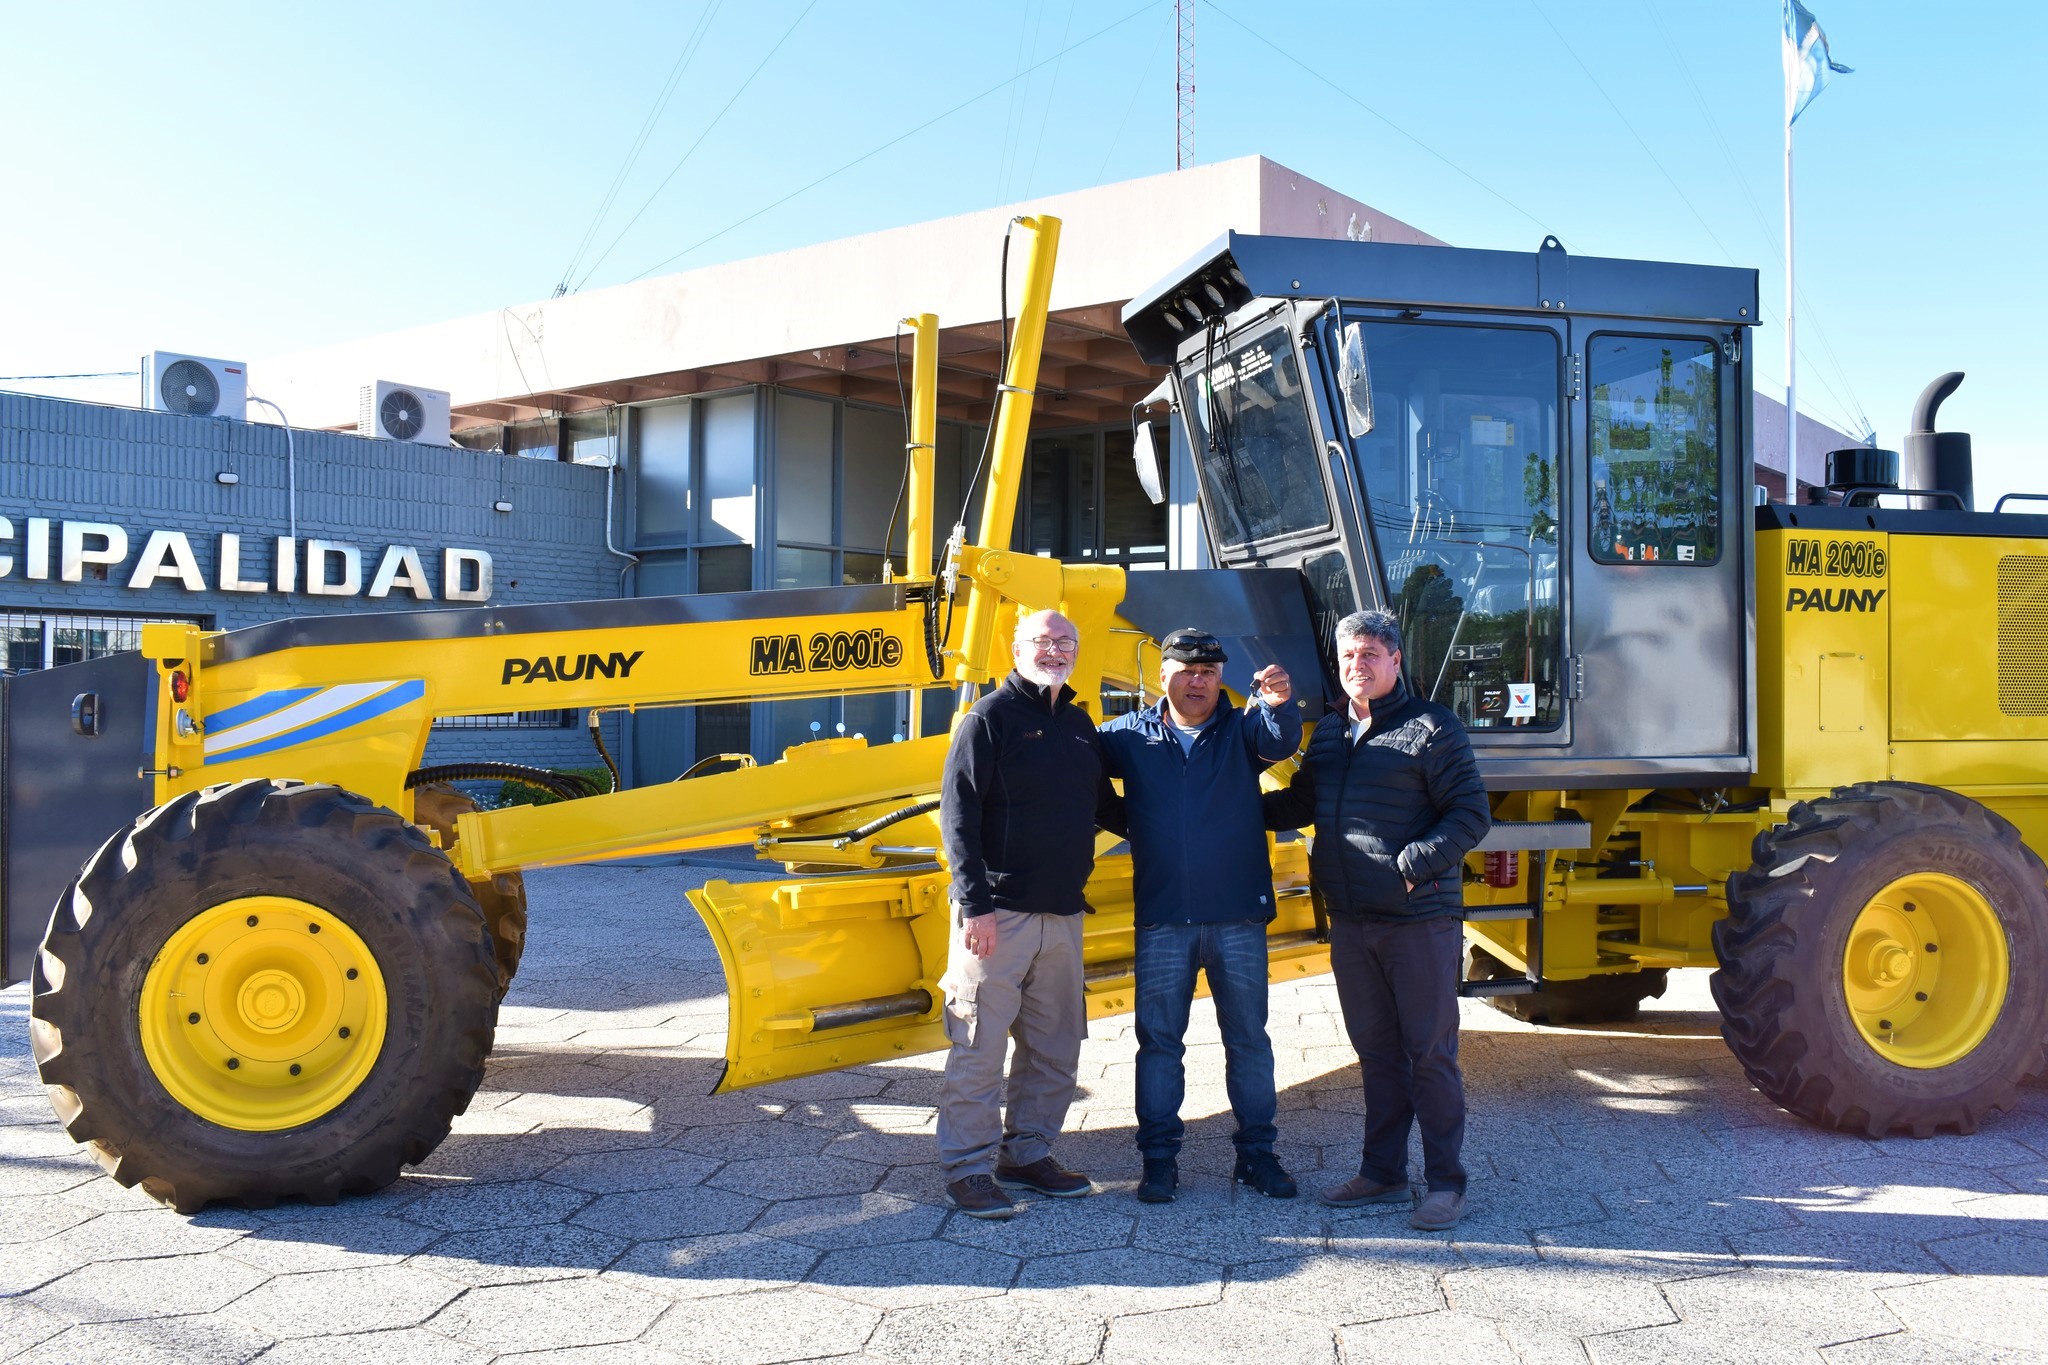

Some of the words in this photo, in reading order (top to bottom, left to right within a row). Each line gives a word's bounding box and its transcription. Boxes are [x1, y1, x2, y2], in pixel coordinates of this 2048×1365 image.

[0, 516, 494, 601] IPALIDAD
[1786, 539, 1822, 576] MA
[1825, 540, 1887, 578] 200ie
[1786, 588, 1887, 612] PAUNY
[501, 651, 645, 685] PAUNY
[750, 635, 805, 675] MA
[809, 628, 903, 672] 200ie
